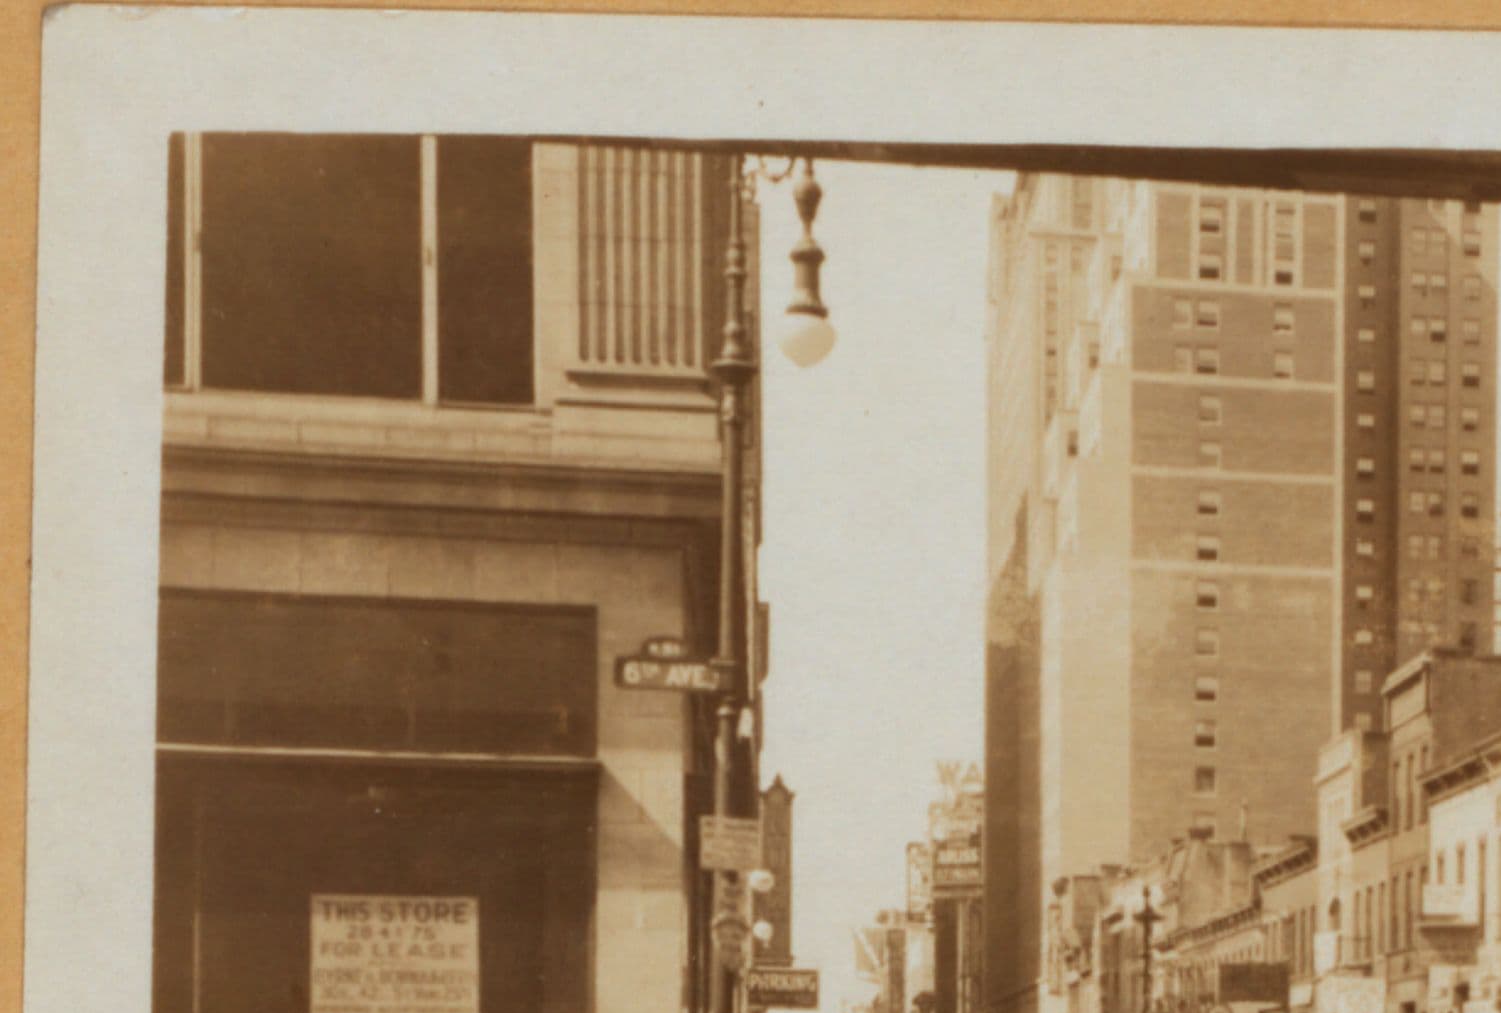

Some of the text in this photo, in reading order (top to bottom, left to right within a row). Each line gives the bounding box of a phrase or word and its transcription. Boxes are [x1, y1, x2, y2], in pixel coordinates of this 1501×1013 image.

[322, 901, 469, 924] THIS STORE
[319, 941, 467, 960] FOR LEASE
